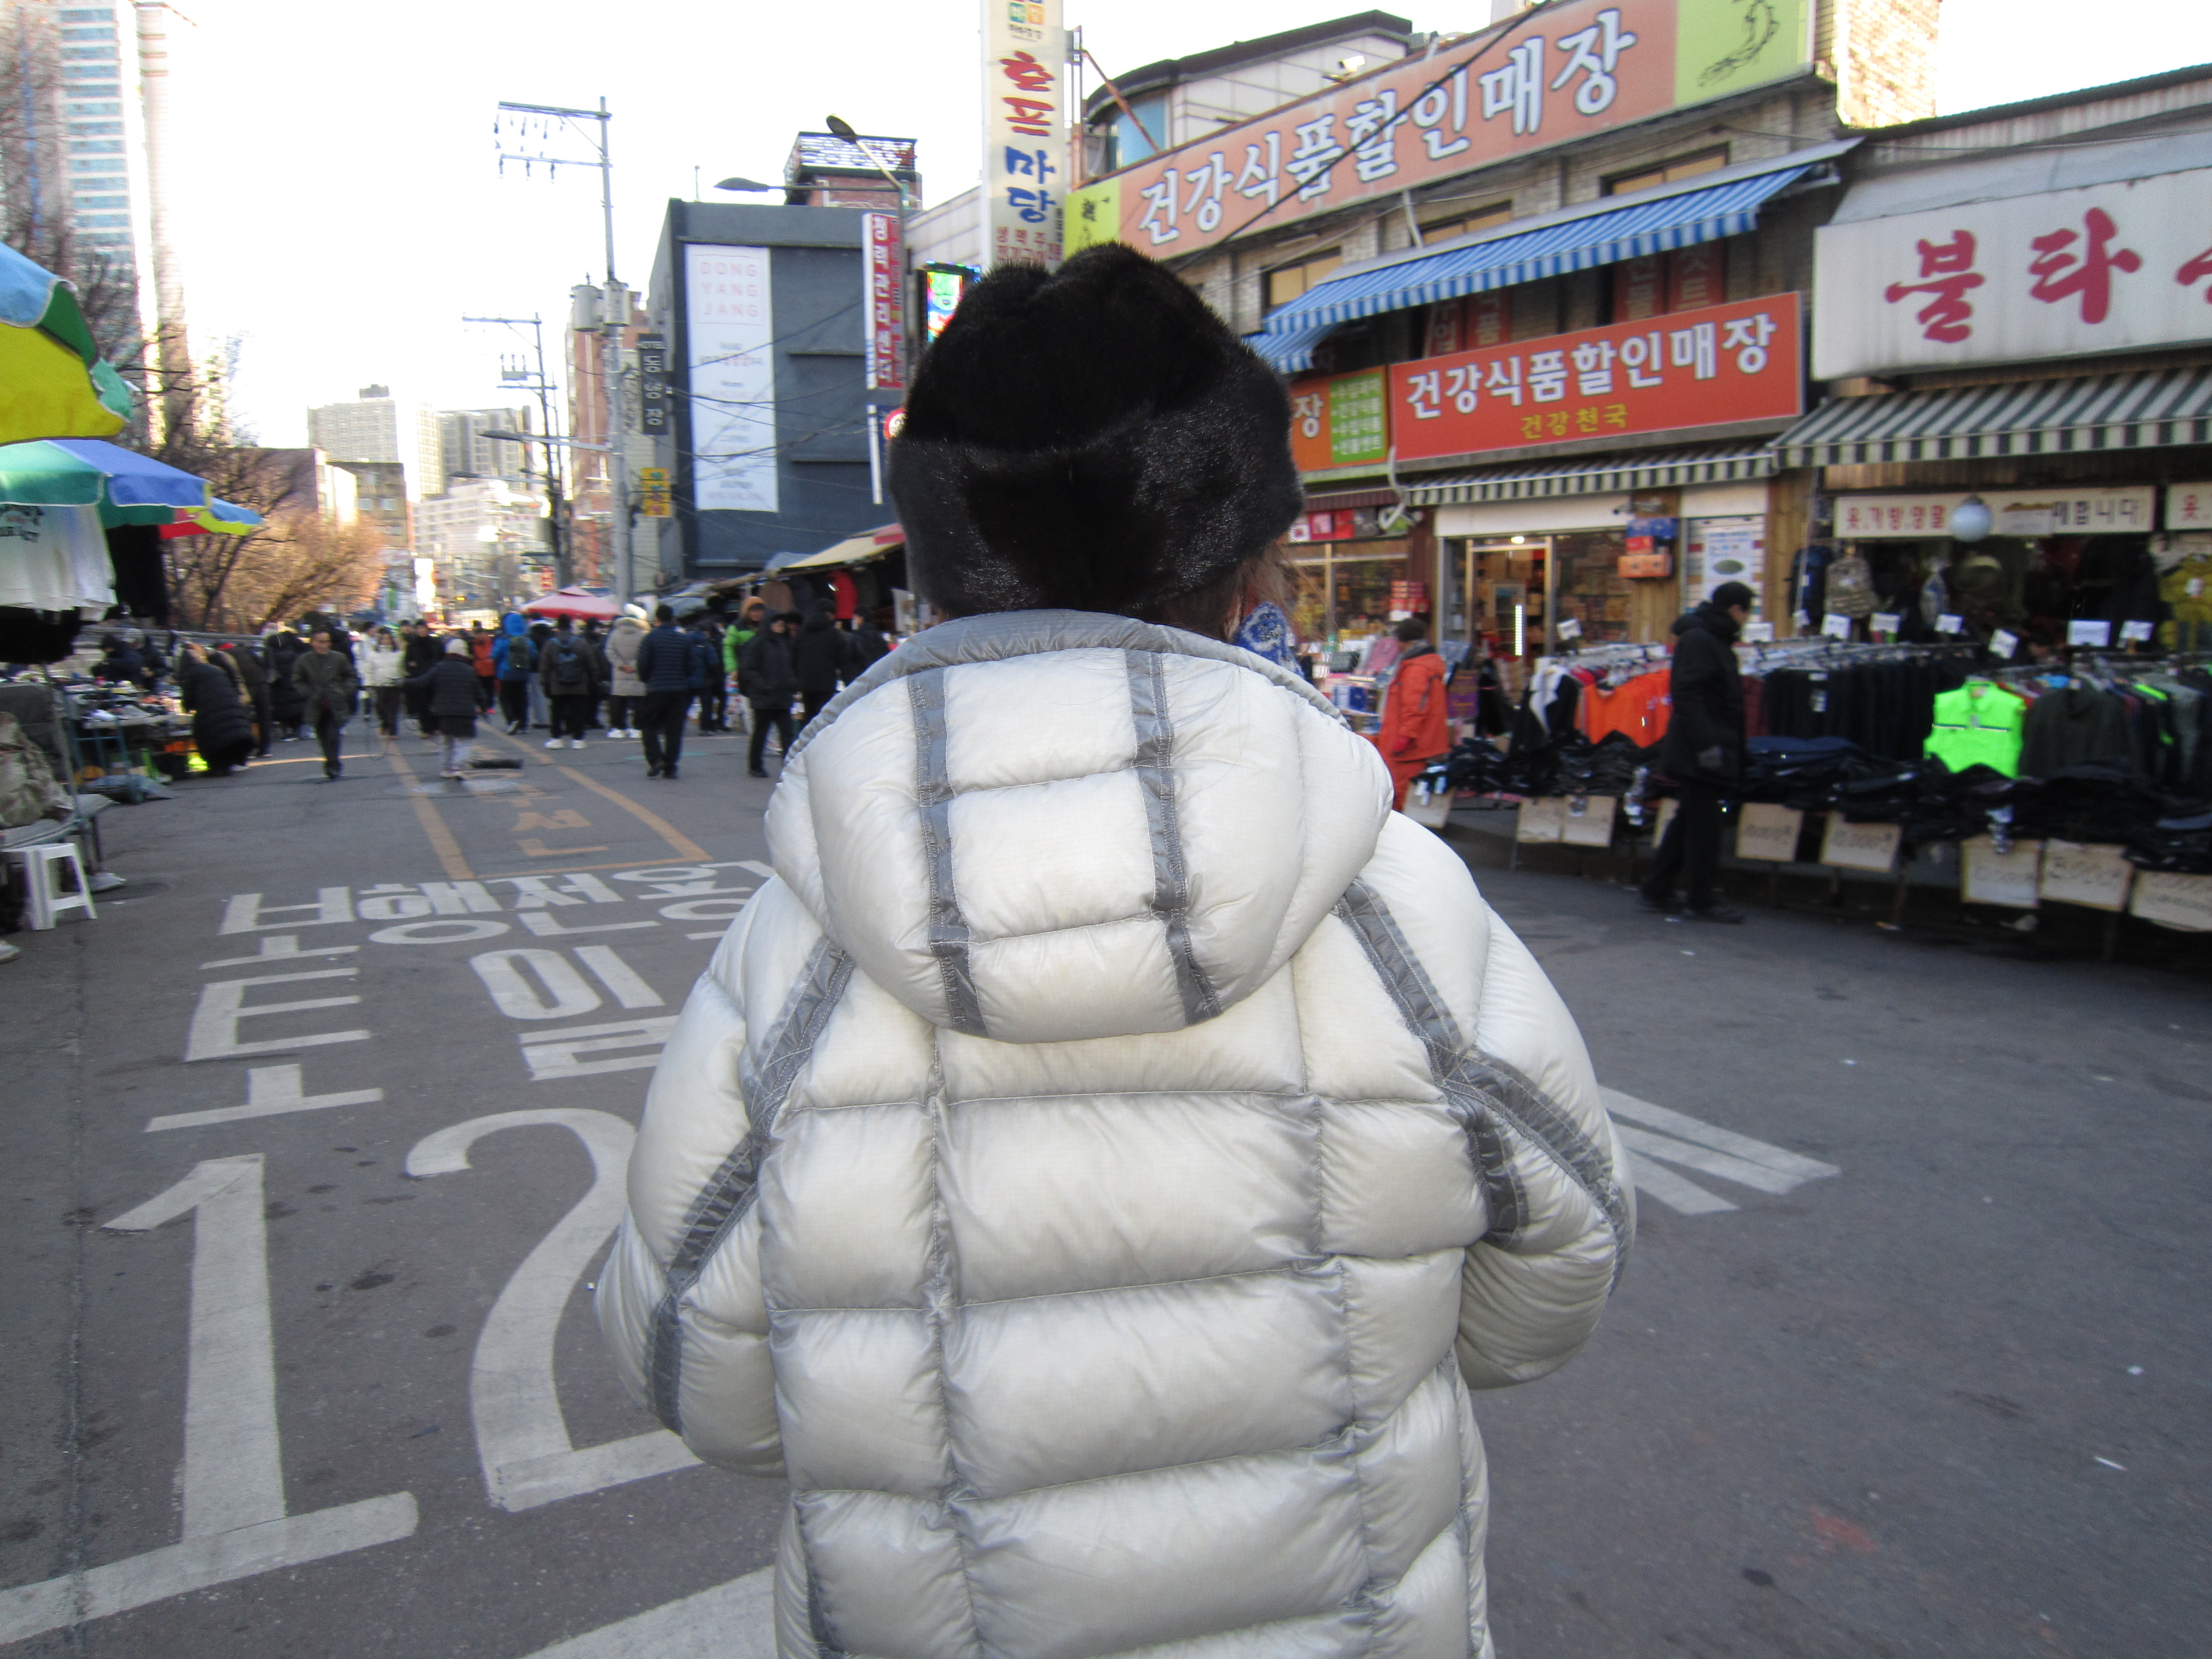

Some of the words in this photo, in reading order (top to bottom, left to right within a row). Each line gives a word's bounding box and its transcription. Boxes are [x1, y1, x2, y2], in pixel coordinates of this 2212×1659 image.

[699, 262, 757, 277] DONG
[701, 282, 759, 297] YANG
[702, 303, 759, 317] JANG
[1407, 312, 1777, 419] 건강식품할인매장
[1293, 392, 1324, 439] 장
